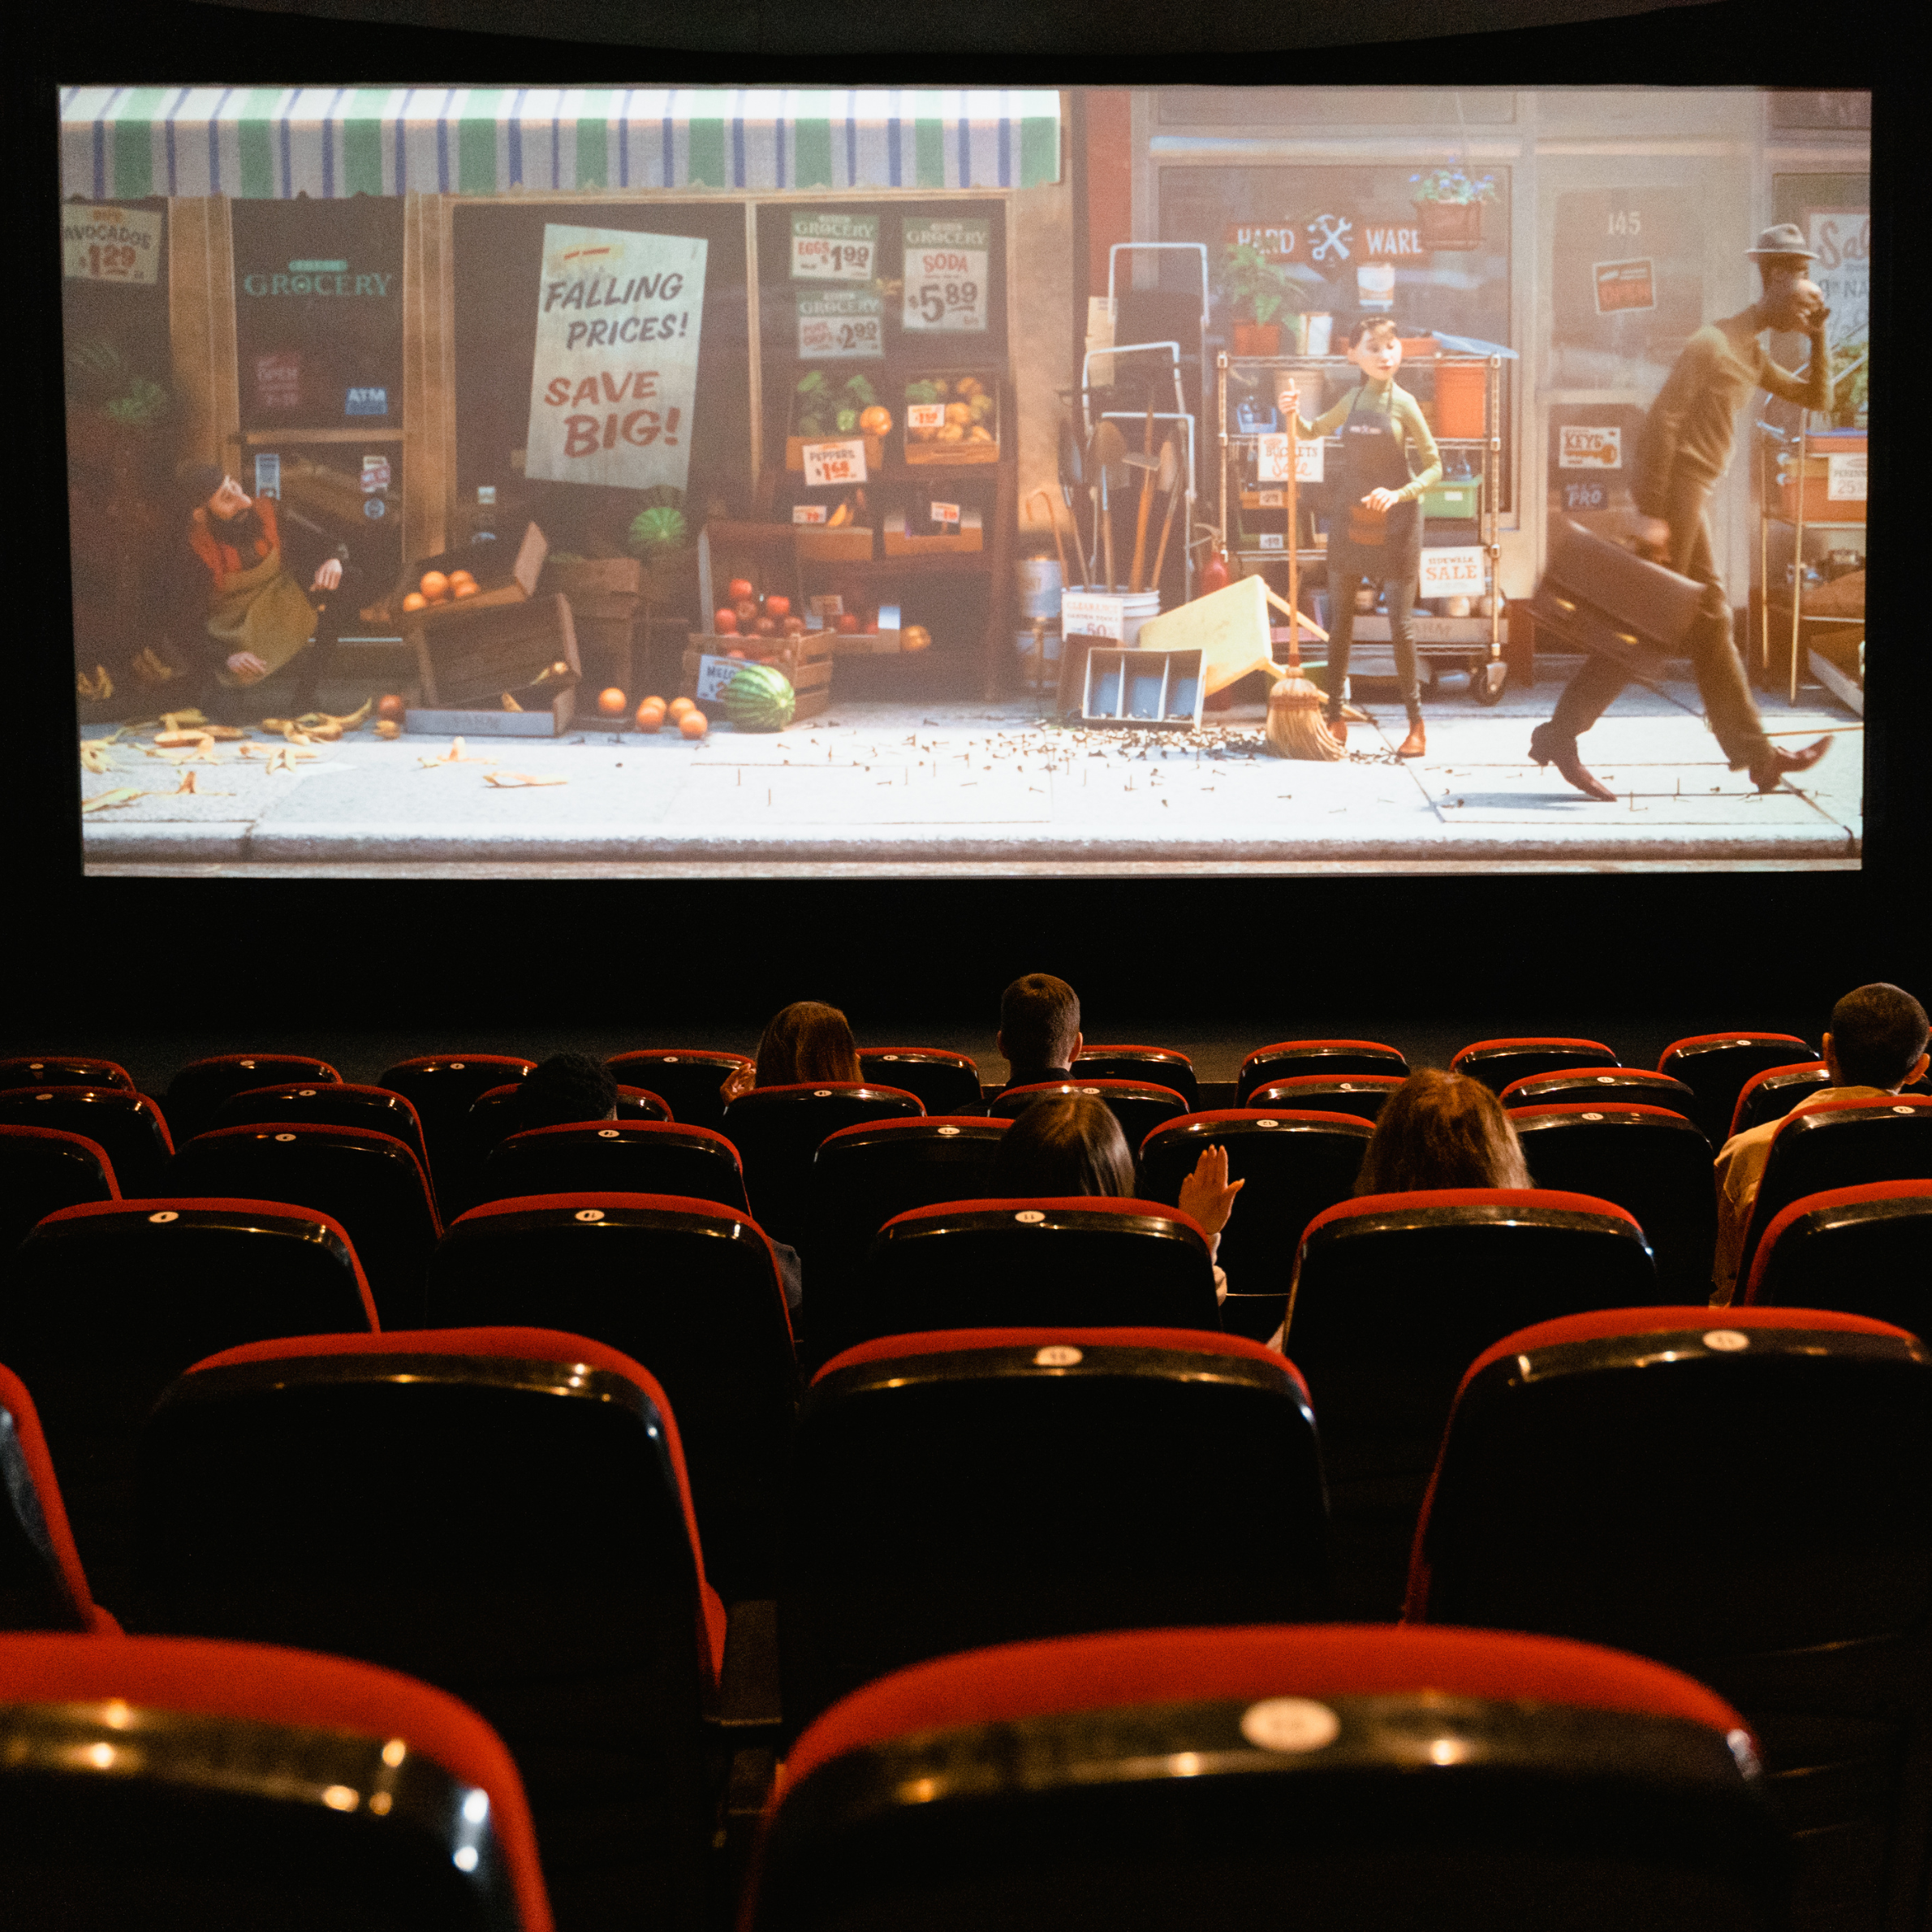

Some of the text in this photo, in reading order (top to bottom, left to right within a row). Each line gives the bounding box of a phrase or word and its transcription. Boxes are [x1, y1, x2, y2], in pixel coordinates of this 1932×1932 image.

[1606, 210, 1641, 235] 145
[798, 241, 830, 256] EGGS
[922, 252, 968, 274] SODA
[244, 273, 392, 297] GROCERY
[543, 272, 684, 313] FALLING
[566, 311, 689, 351] PRICES!
[347, 388, 386, 402] ATM
[544, 370, 660, 408] SAVE
[564, 407, 681, 459] BIG!
[1564, 434, 1604, 451] KEYS
[809, 449, 855, 461] PEPPERS
[1425, 565, 1477, 582] SALE
